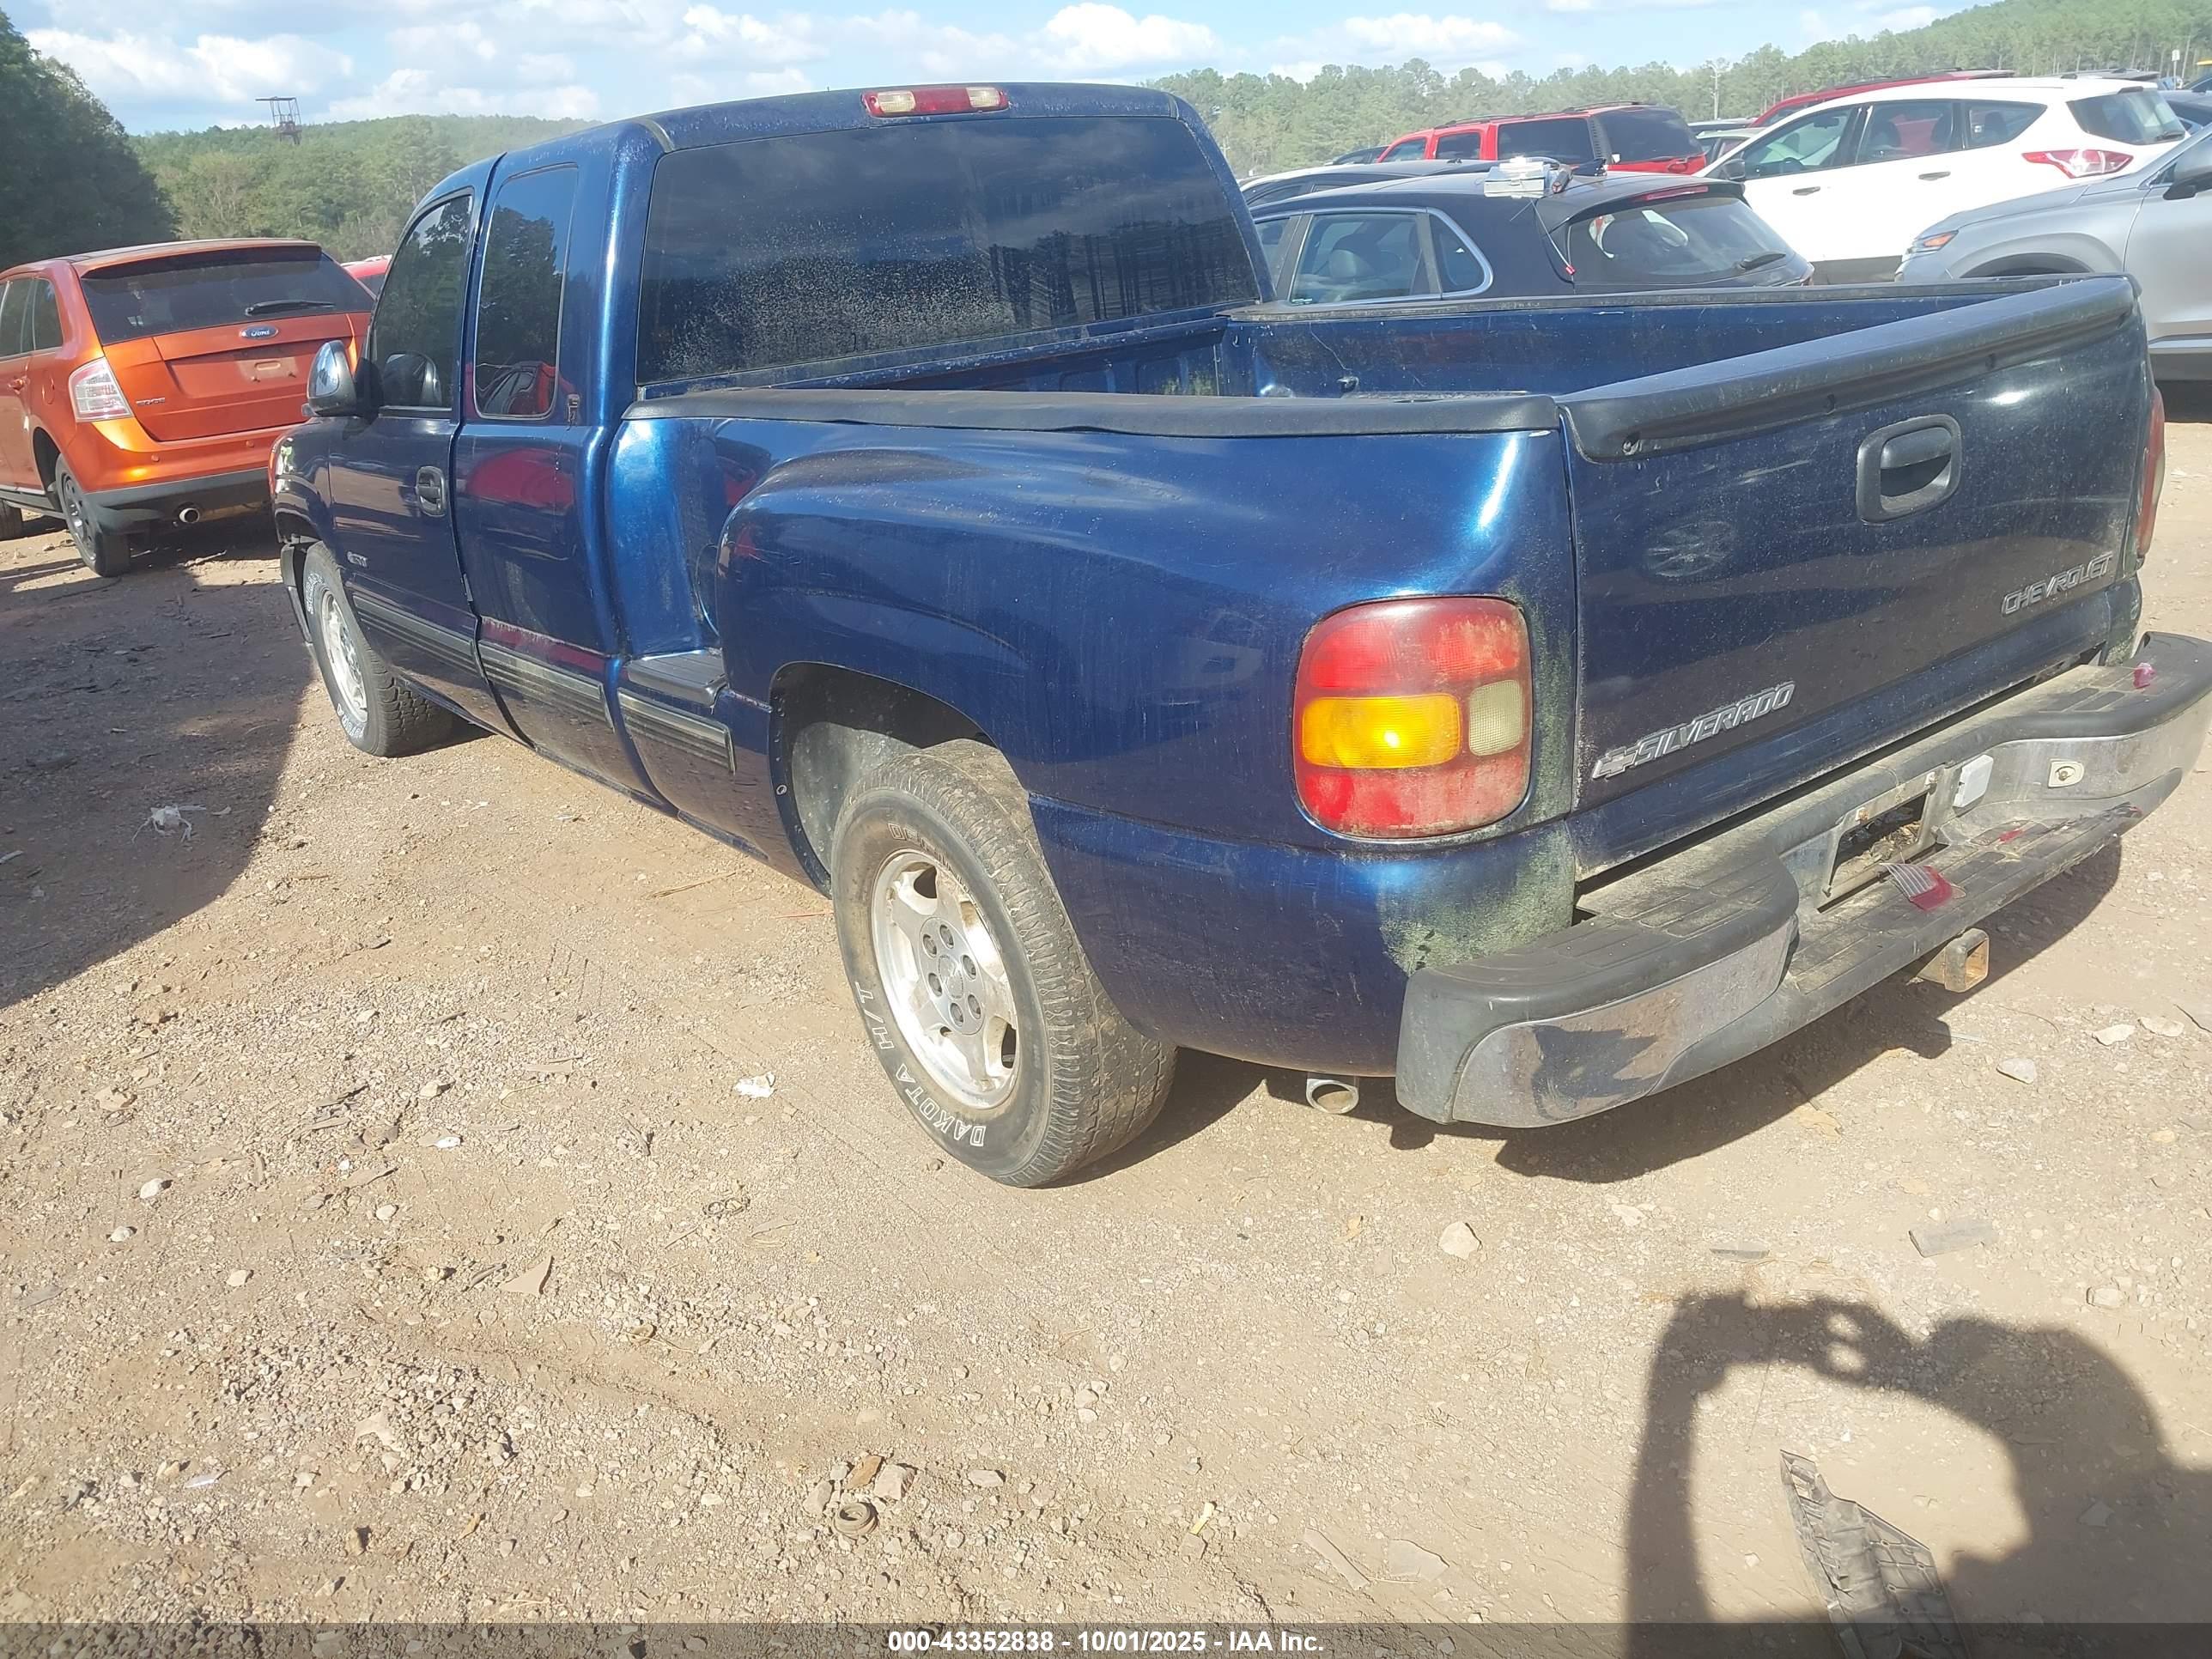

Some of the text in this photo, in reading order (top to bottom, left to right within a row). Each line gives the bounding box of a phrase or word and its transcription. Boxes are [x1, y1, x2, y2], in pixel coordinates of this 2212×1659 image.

[2002, 551, 2113, 615] CHEVROLET
[1634, 681, 1796, 766] SILVERADO
[896, 1063, 987, 1147] DAKOTA
